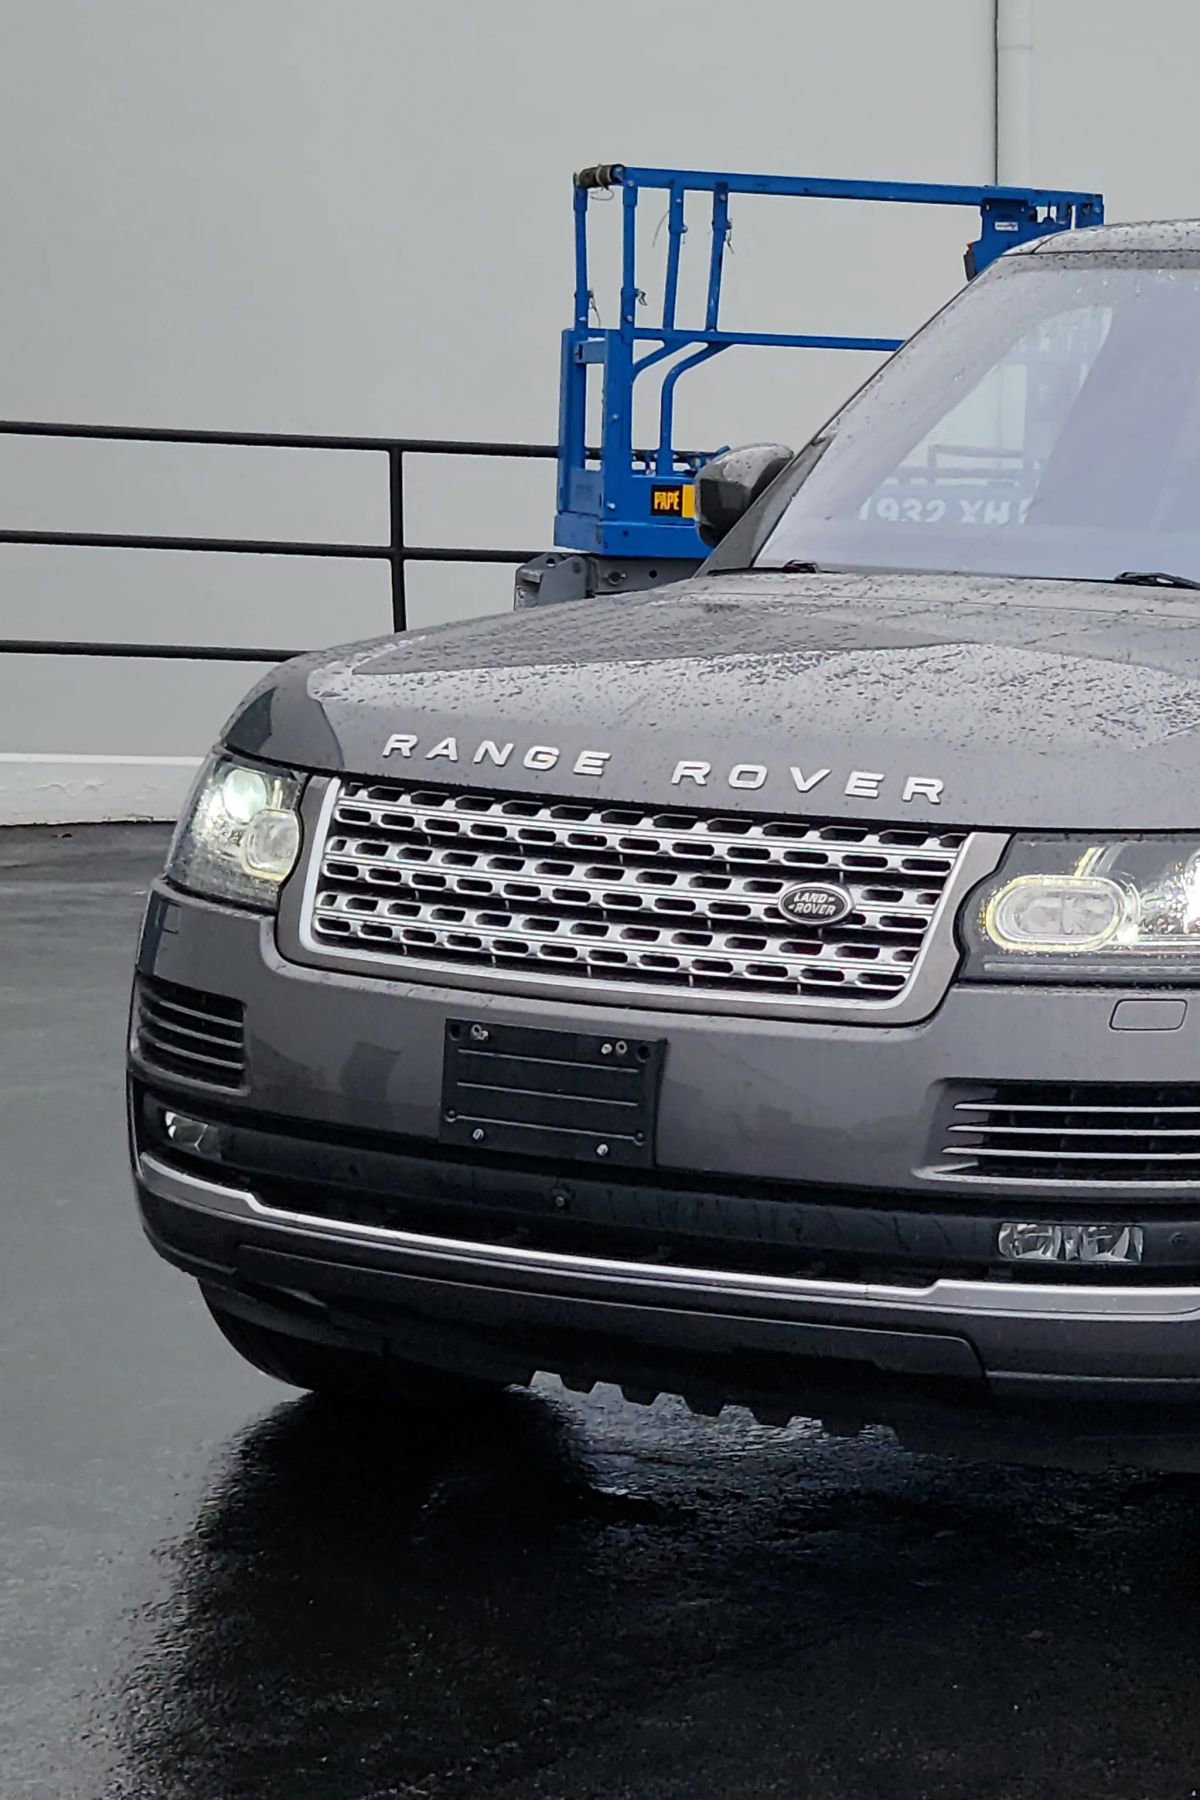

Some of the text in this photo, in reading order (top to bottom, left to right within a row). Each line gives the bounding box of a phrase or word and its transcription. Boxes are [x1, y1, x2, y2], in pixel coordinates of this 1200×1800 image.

[382, 734, 944, 804] RANGE ROVER
[794, 892, 829, 903] LAND
[794, 902, 837, 916] ROVER
